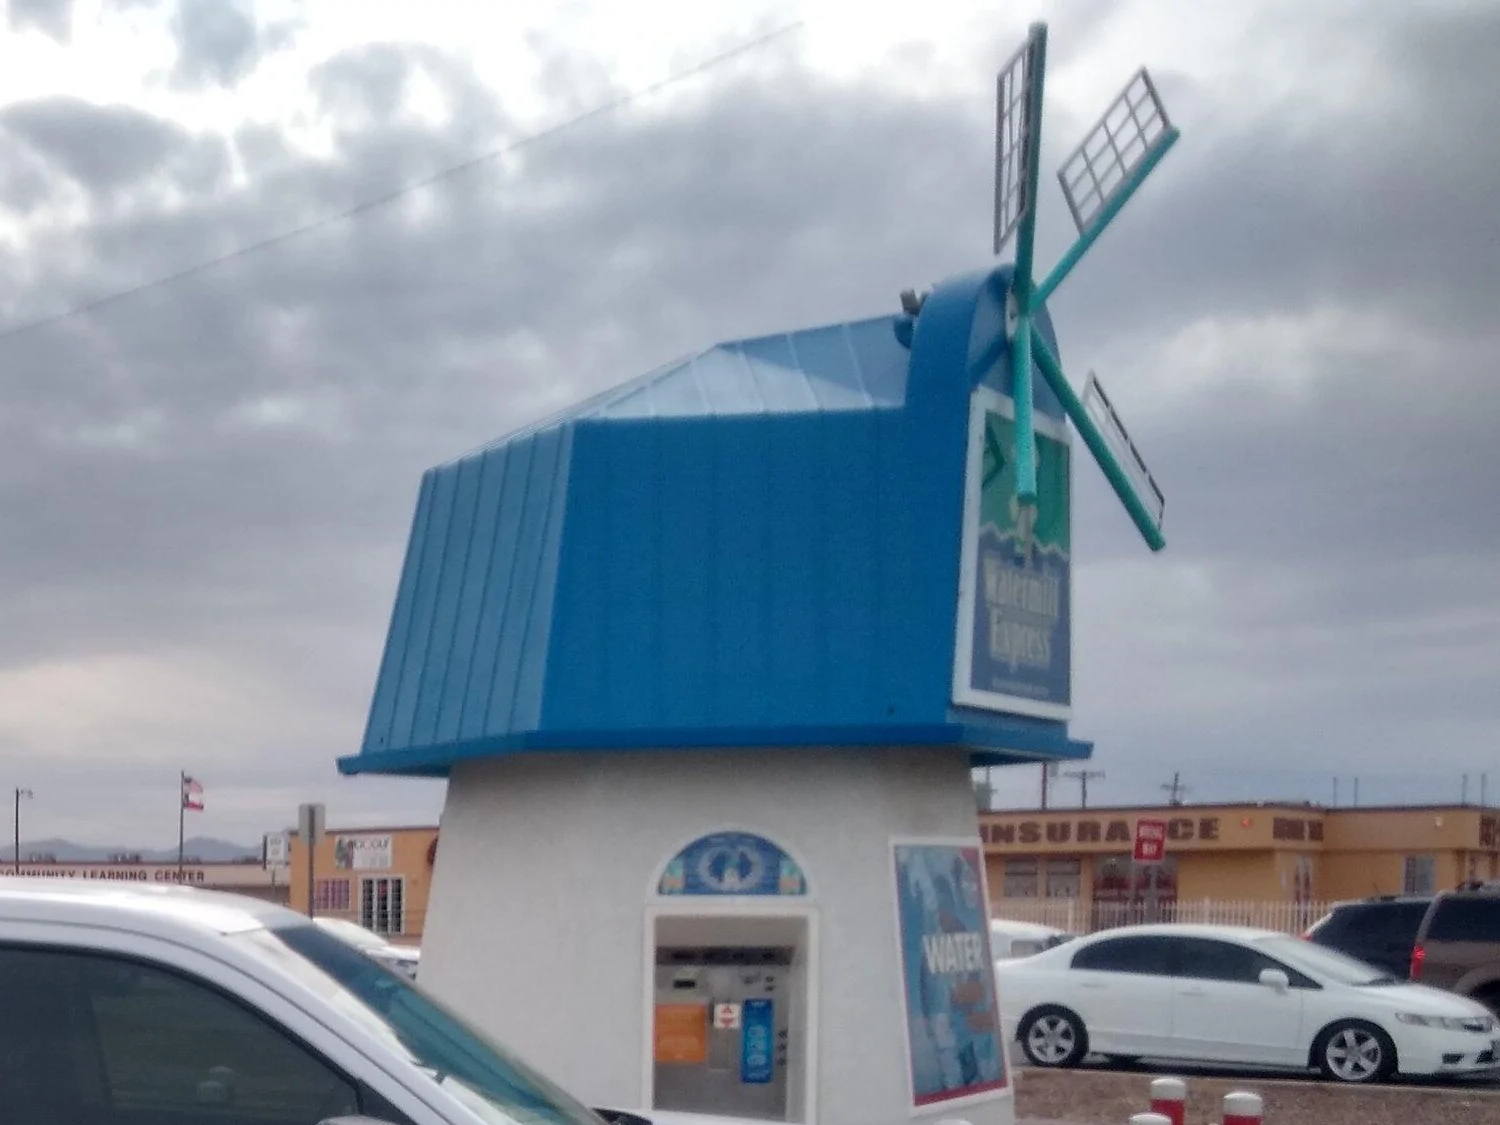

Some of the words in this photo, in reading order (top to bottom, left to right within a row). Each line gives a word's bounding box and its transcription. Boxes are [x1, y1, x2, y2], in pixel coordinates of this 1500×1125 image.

[978, 816, 1220, 844] INSURACE
[82, 869, 148, 881] LEARNING
[153, 868, 205, 883] CENTER
[922, 931, 983, 975] WATER
